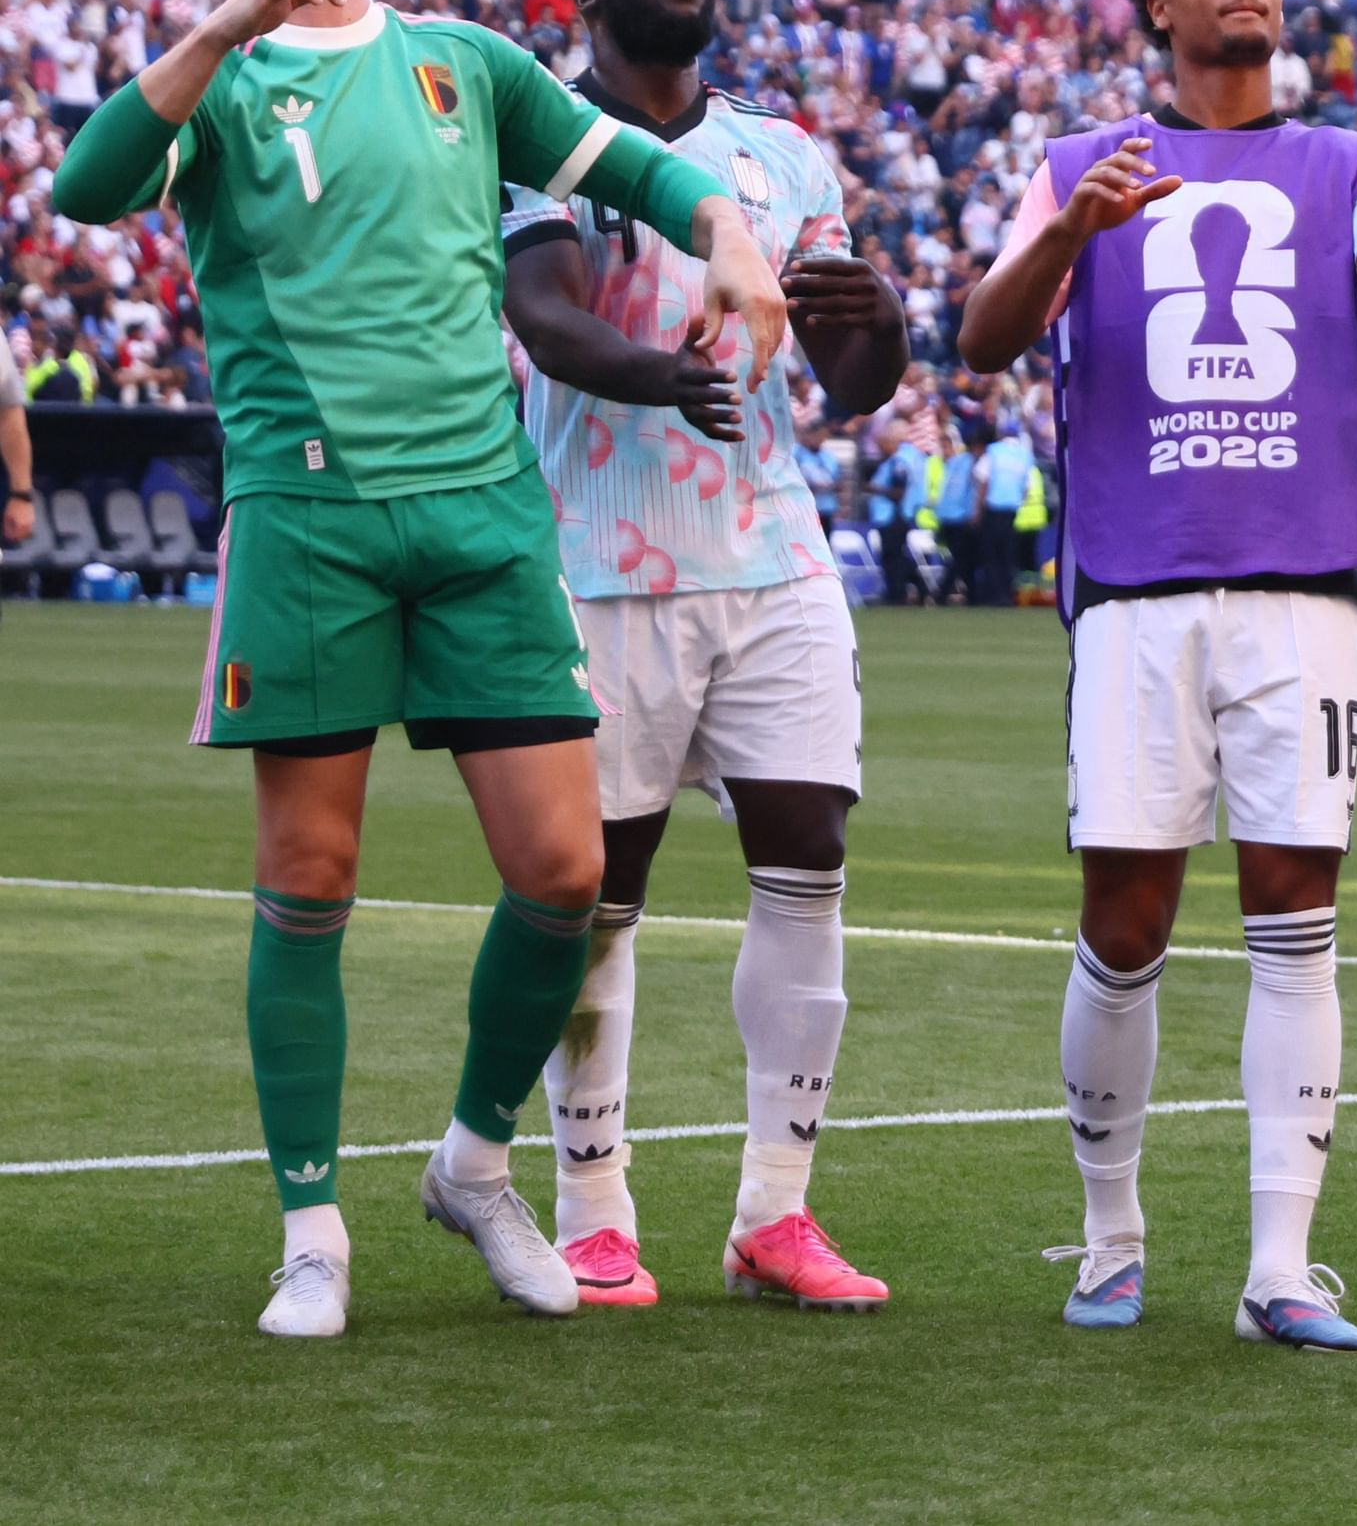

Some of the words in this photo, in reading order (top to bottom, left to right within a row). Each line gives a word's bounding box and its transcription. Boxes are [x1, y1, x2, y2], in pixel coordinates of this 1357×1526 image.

[284, 126, 323, 203] 1
[1187, 356, 1255, 380] FIFA
[1149, 410, 1240, 437] WORLD
[1244, 411, 1297, 432] CUP
[1149, 434, 1298, 475] 2026
[1063, 1076, 1117, 1102] BFA
[557, 1100, 621, 1120] RBFA
